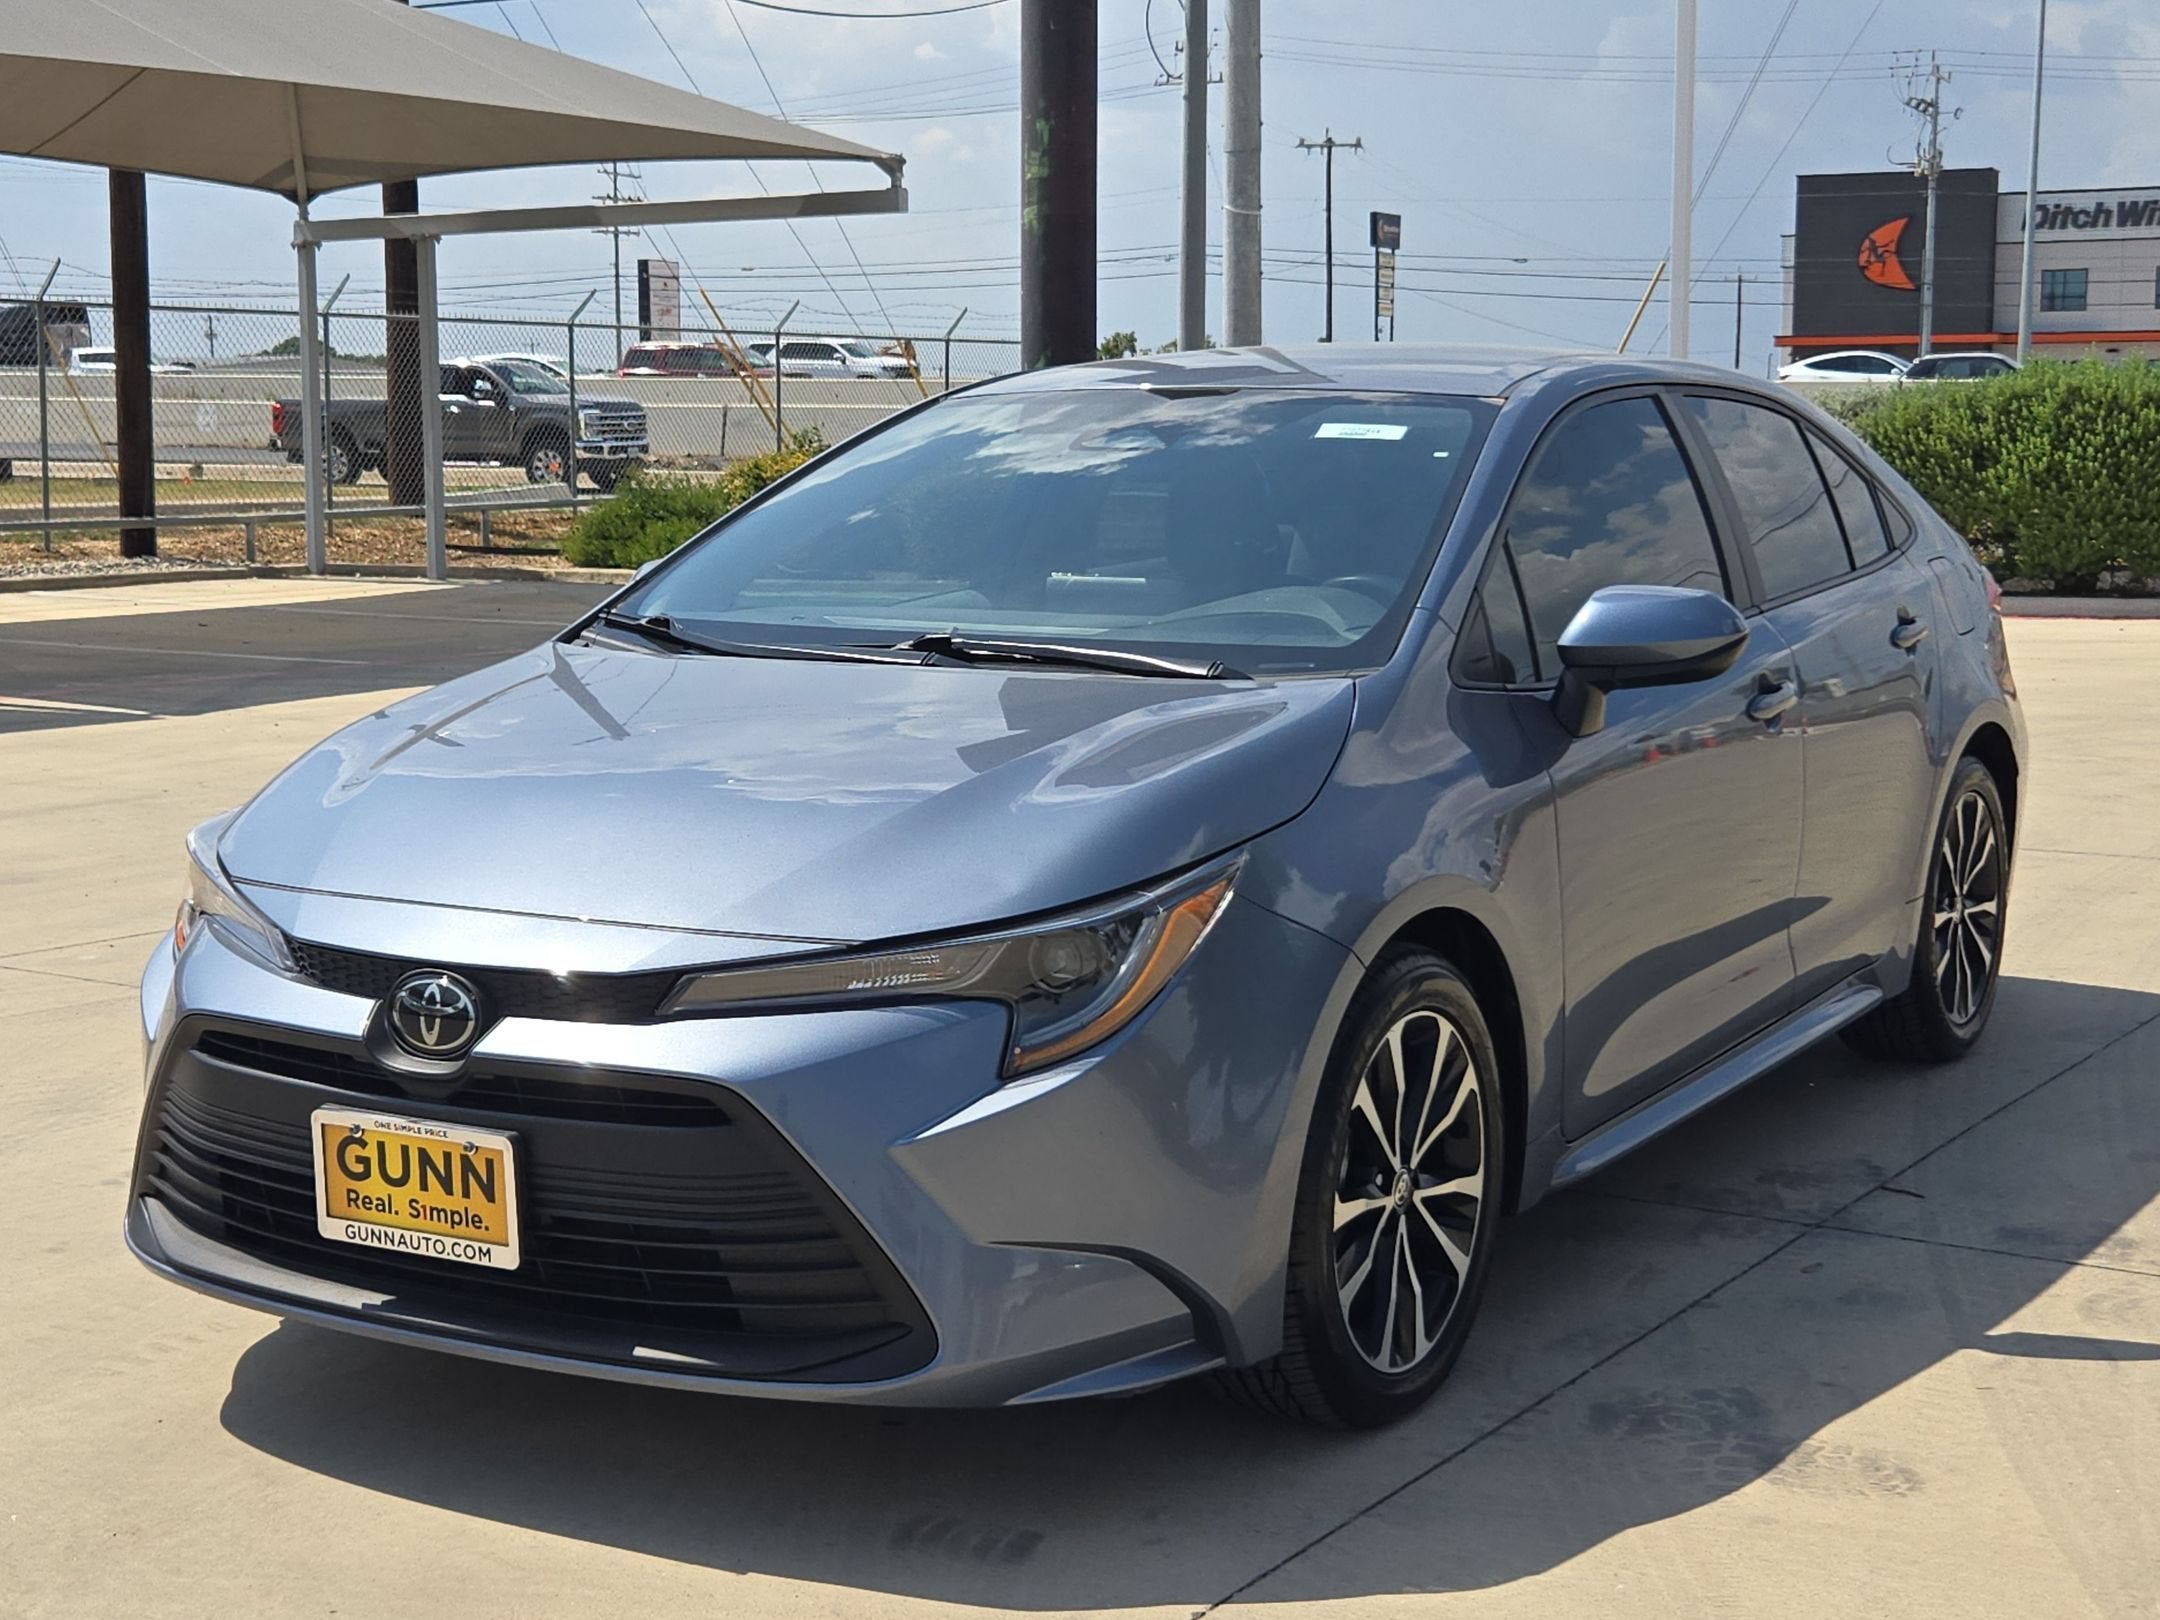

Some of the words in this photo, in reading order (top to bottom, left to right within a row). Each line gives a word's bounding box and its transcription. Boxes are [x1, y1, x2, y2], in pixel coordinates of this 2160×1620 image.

[374, 1120, 392, 1130] ONE
[424, 1127, 449, 1139] PRICE
[336, 1134, 496, 1204] GUNN
[346, 1188, 399, 1216] Real.
[344, 1223, 492, 1263] GUNNAUTO.COM
